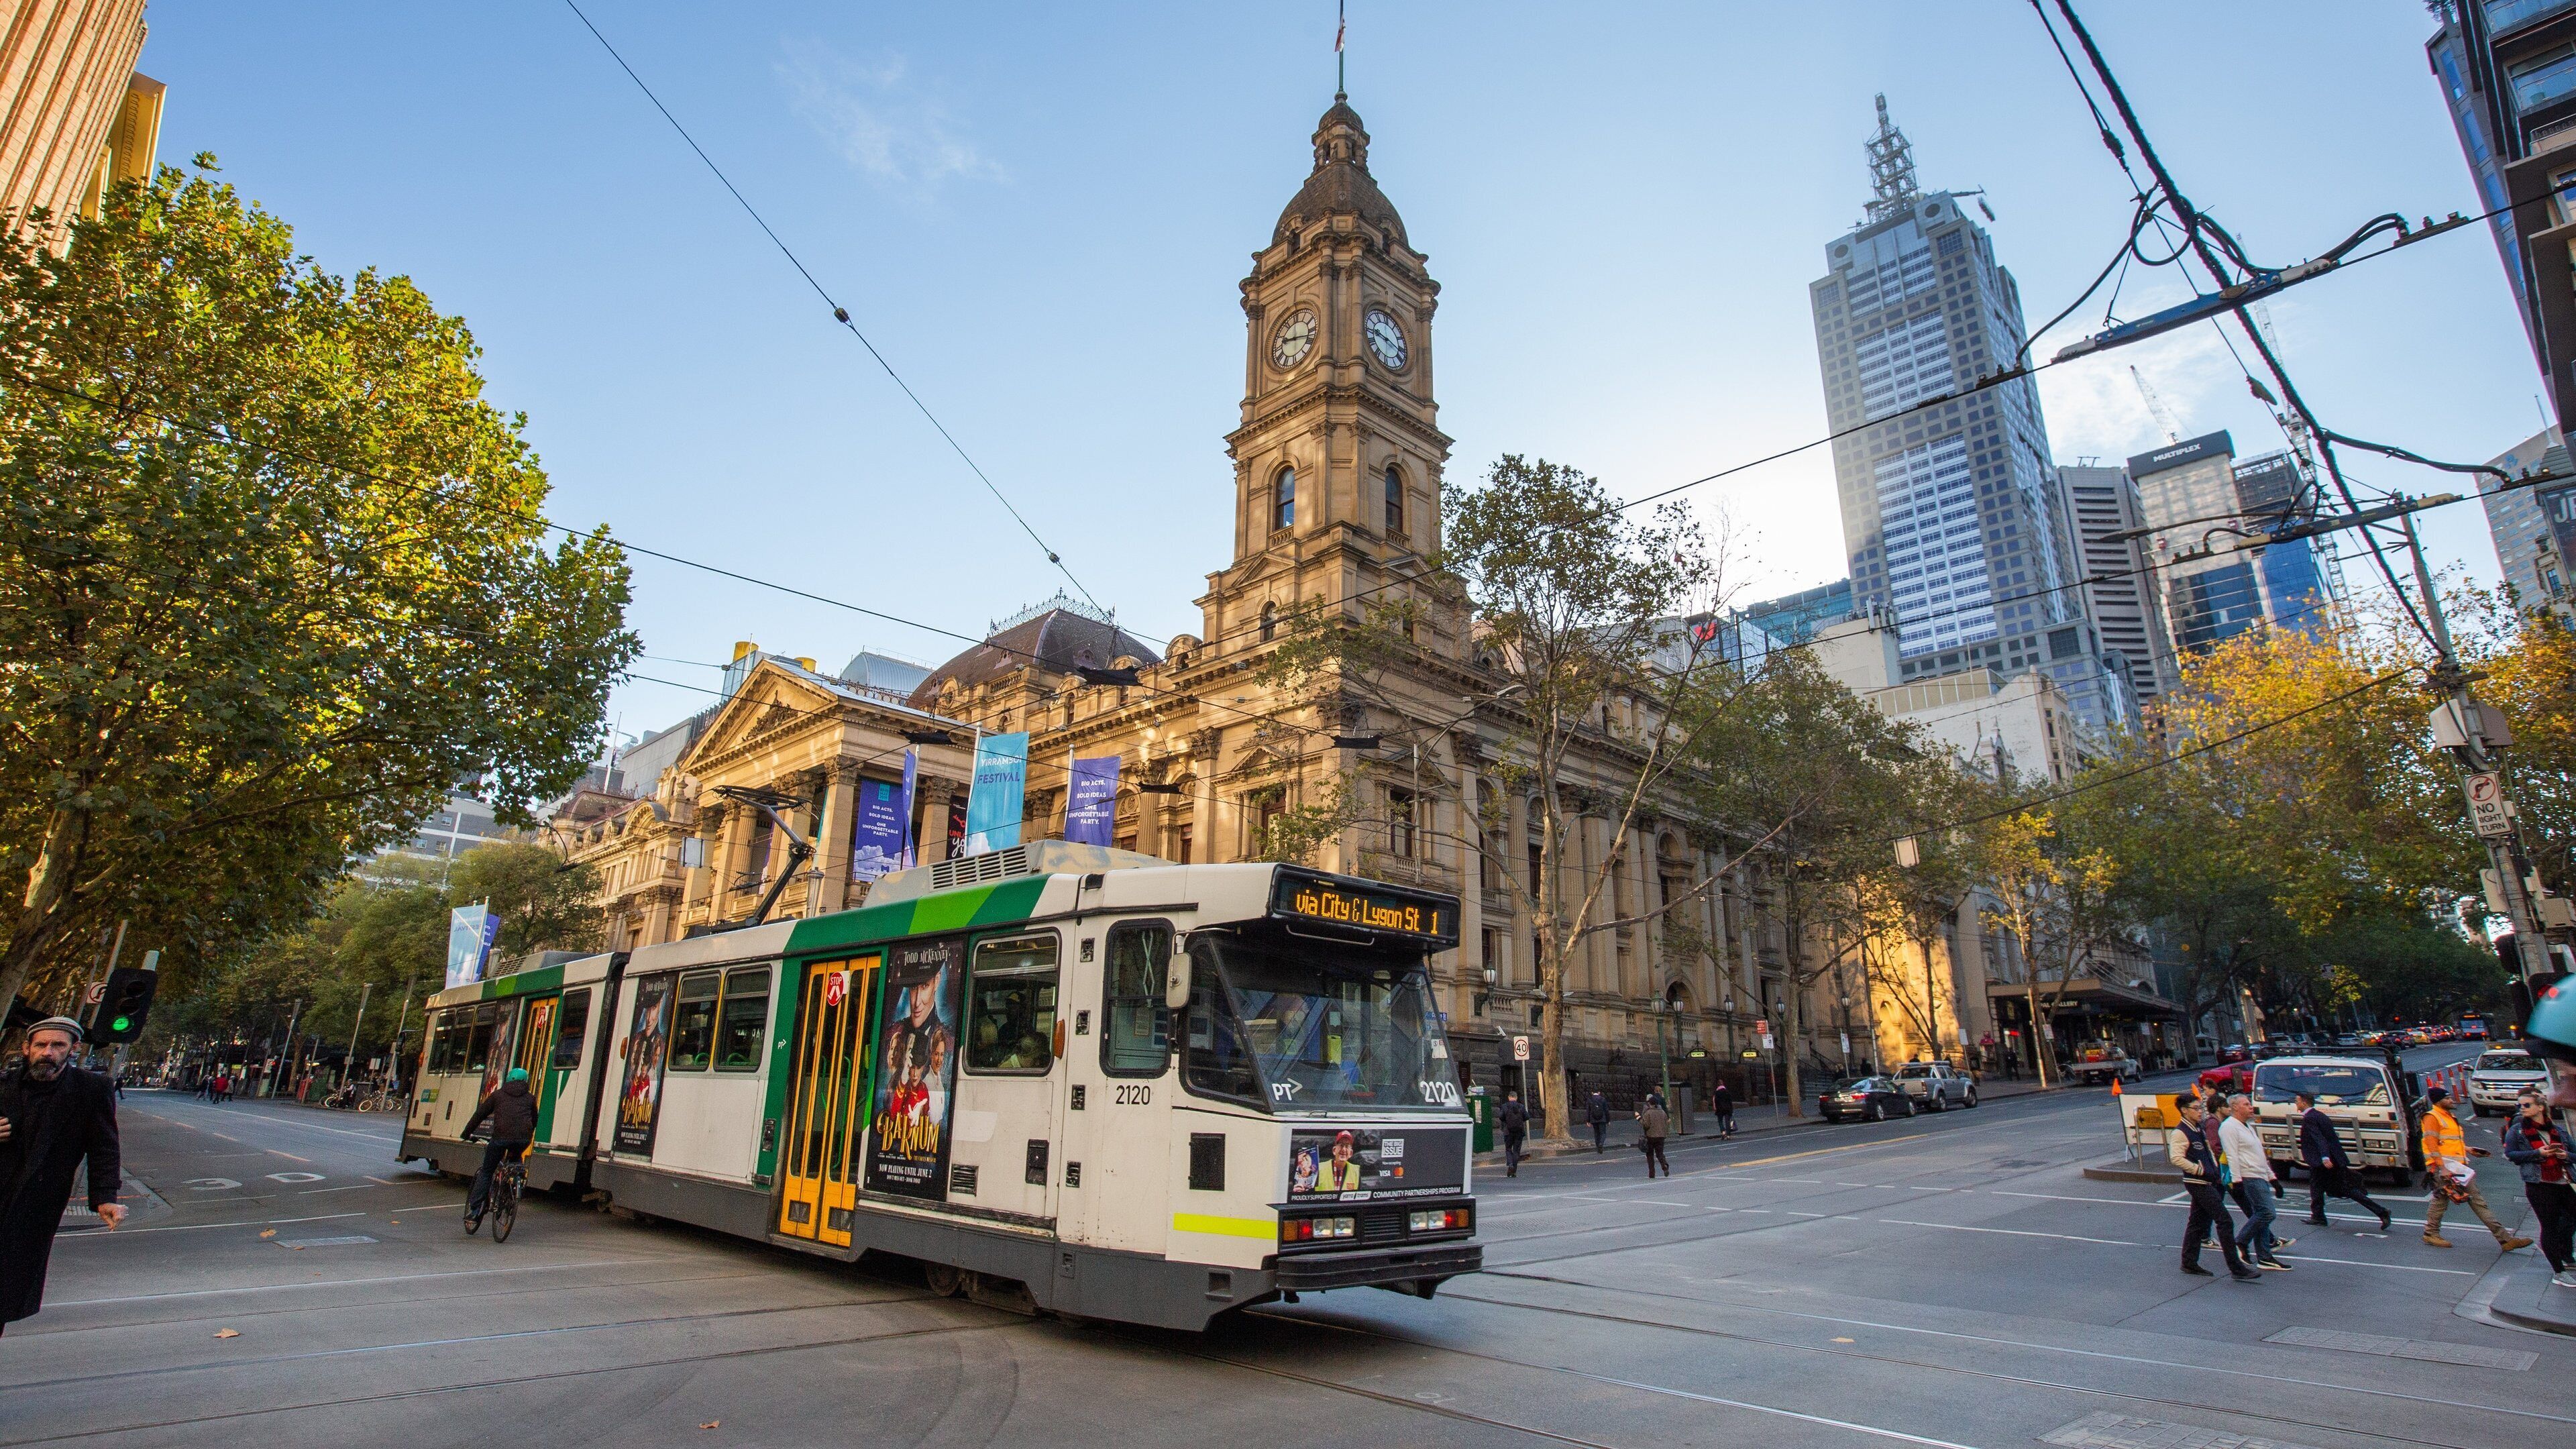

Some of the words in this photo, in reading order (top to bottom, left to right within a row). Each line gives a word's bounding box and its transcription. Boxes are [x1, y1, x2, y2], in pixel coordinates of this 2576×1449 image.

[2153, 443, 2201, 462] MULTIPLEX
[981, 755, 1022, 766] YIRRAMBOI
[977, 771, 1020, 784] FESTIVAL
[2476, 803, 2494, 814] NO
[2478, 813, 2502, 823] RIGHT
[862, 824, 899, 835] UNFORGETTABLE
[2480, 822, 2506, 832] TURN
[949, 830, 965, 838] UNL
[1296, 890, 1318, 916] via
[1321, 893, 1350, 920] City
[1362, 900, 1402, 929] Lygon
[1405, 907, 1419, 932] St
[1431, 912, 1438, 934] 1
[904, 951, 918, 966] TODD
[830, 976, 843, 985] STOP
[1517, 1044, 1527, 1052] 40
[1116, 1085, 1150, 1105] 2120
[1272, 1083, 1292, 1101] PT
[1420, 1081, 1458, 1103] 2120
[877, 1110, 939, 1160] BARNUM
[1383, 1146, 1402, 1155] ISSUE
[879, 1163, 887, 1172] NOW
[888, 1164, 904, 1175] PLAYING
[904, 1166, 916, 1176] UNTIL
[917, 1167, 928, 1177] JUNE
[928, 1169, 932, 1178] 2
[1373, 1190, 1405, 1198] COMMUNITY
[1405, 1188, 1439, 1197] PARTNERSHIPS
